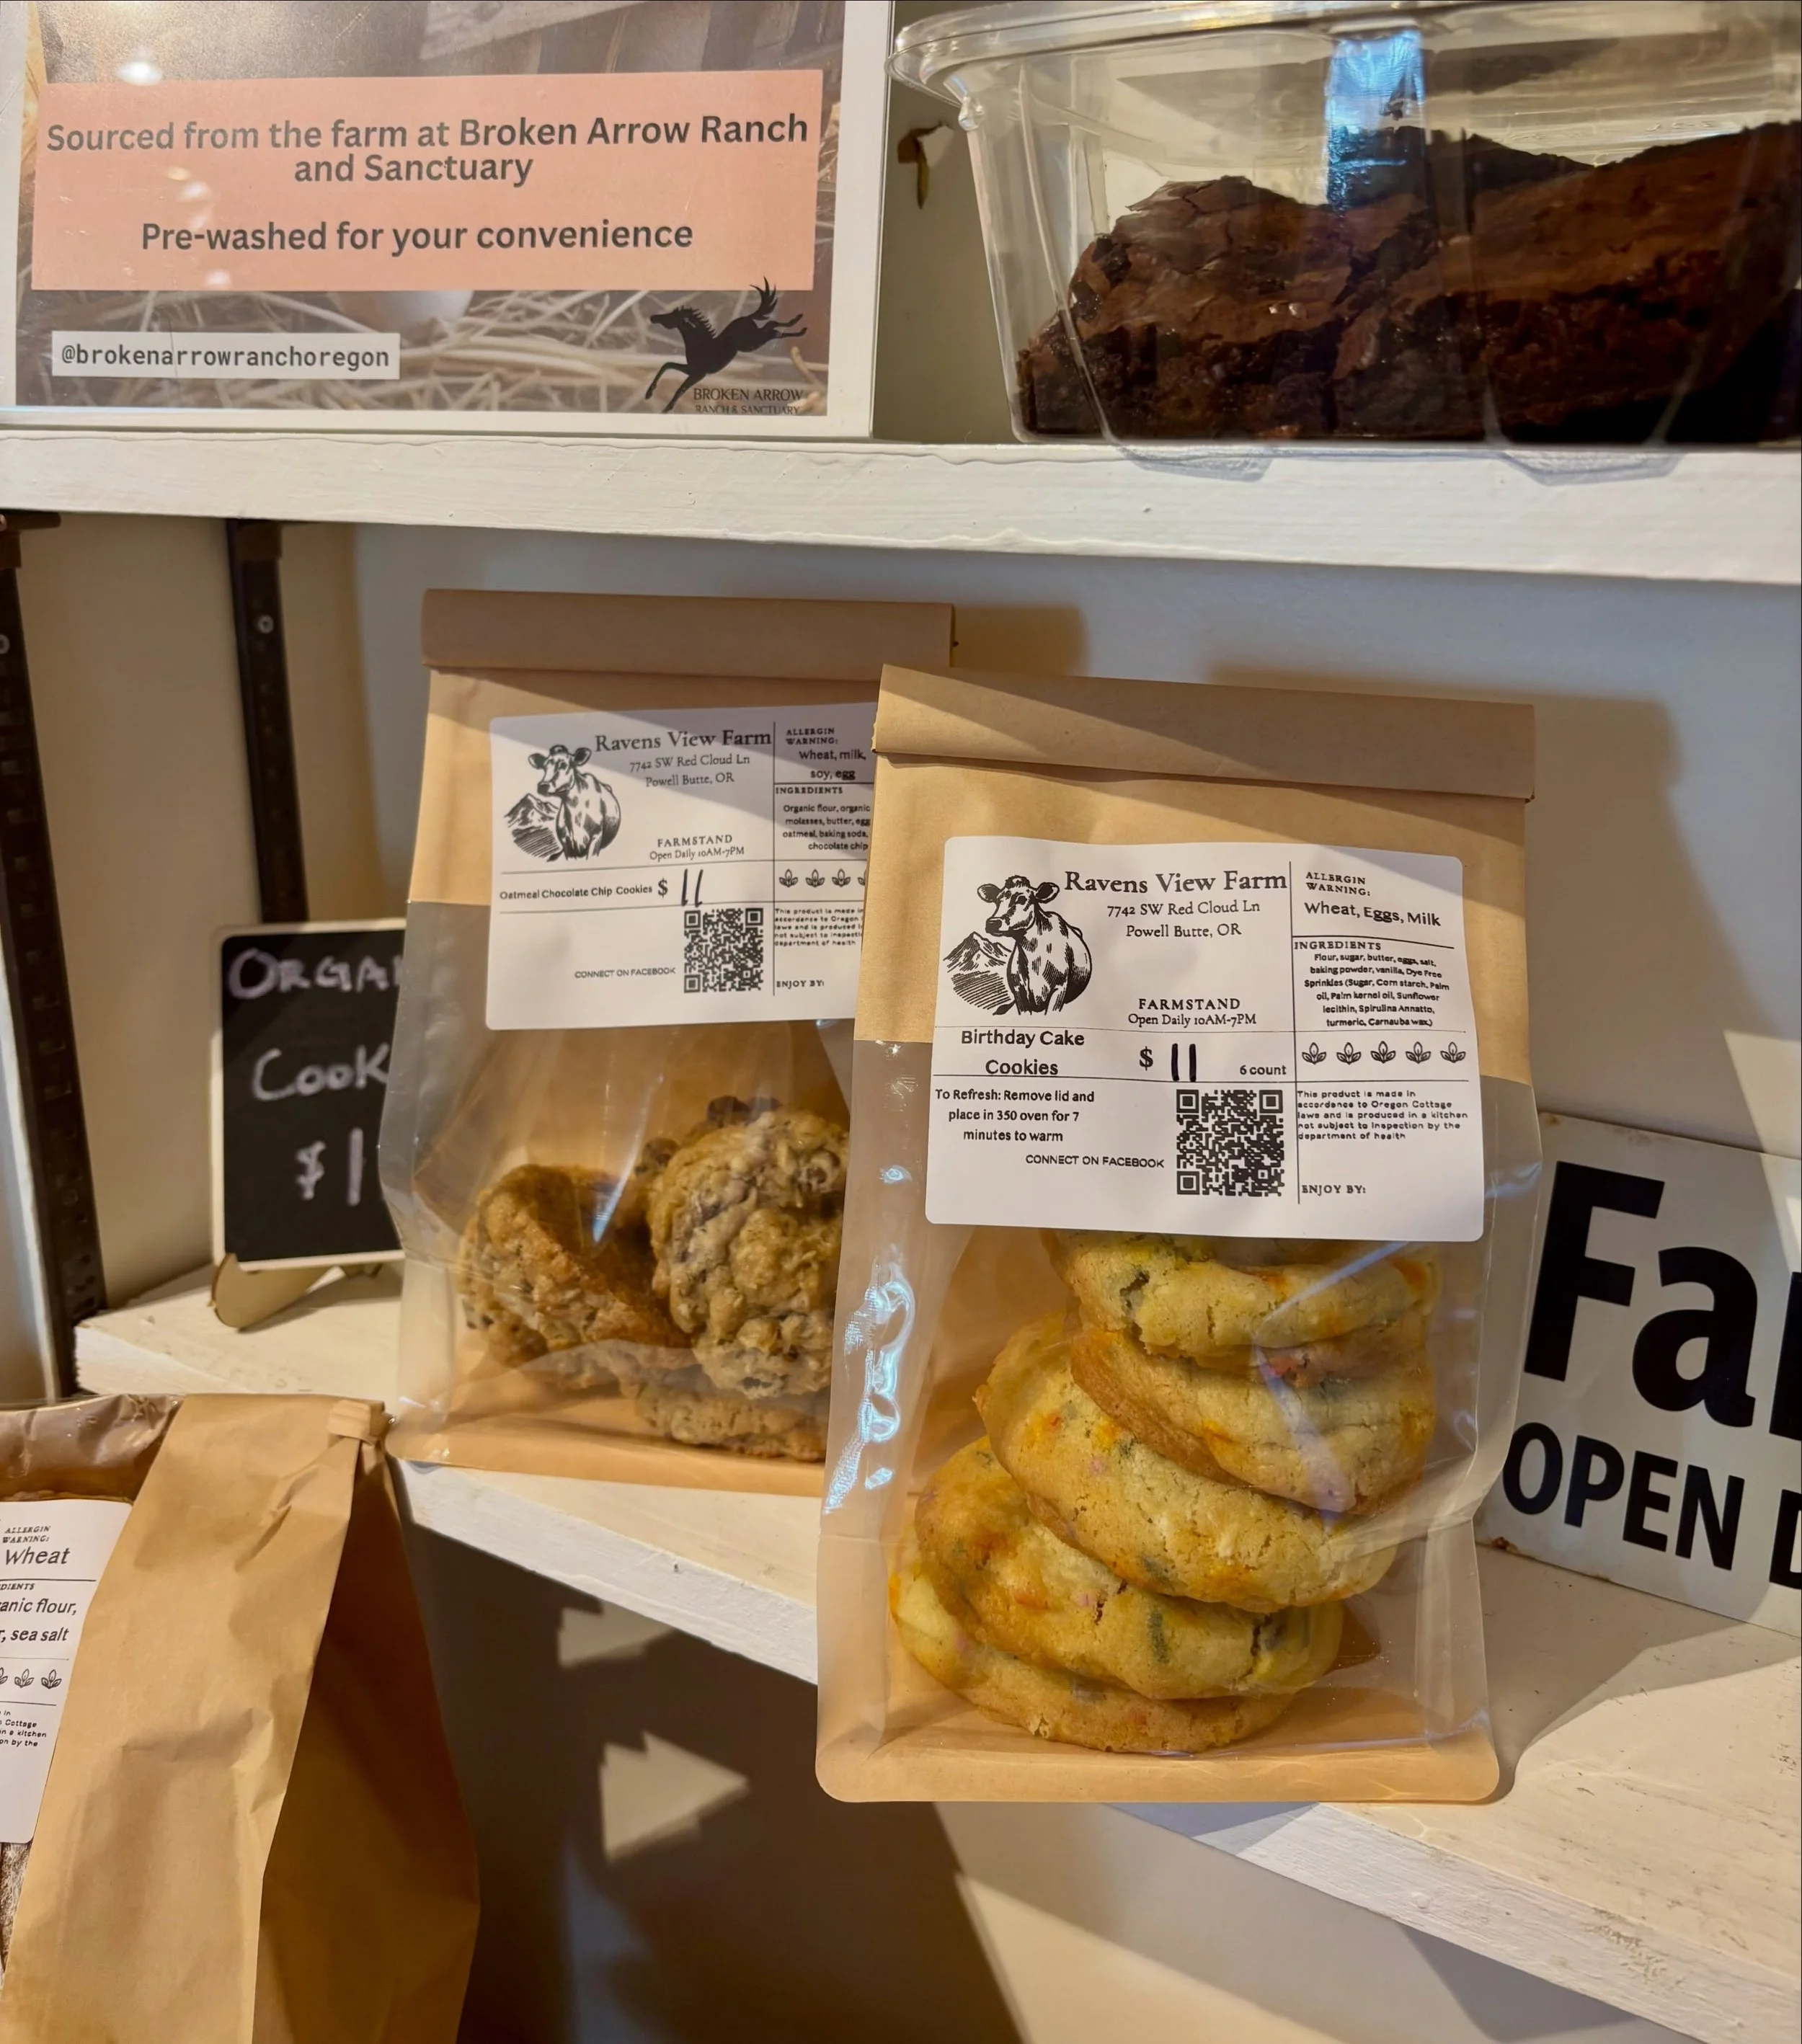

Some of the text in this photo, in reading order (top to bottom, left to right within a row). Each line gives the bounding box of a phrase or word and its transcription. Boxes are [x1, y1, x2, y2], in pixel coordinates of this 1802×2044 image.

[46, 113, 809, 151] Sourced from the farm at Broken Arrow Ranch
[294, 153, 534, 189] and Sanctuary
[142, 219, 694, 257] Pre-washed for your convenience
[61, 343, 391, 372] @brokenarrowranchoregon
[693, 388, 804, 401] BROKEN ARROW
[695, 404, 801, 415] RANCH & SANCTUARY
[786, 727, 835, 736] ALLERGIN
[595, 729, 772, 752] Ravens View Farm
[629, 753, 750, 773] 7742 SW Red Cloud Ln
[645, 772, 735, 787] Powell Butte, OR
[810, 770, 856, 781] soy, egg
[783, 804, 871, 814] Organic flour, organic
[657, 834, 734, 848] FARMSTAND
[649, 850, 673, 862] Open
[675, 848, 696, 861] Daily
[1064, 870, 1288, 894] Ravens View Farm
[1305, 871, 1366, 885] ALLERGIN
[500, 889, 540, 900] Oatmeal
[541, 887, 589, 899] Chocolate
[591, 887, 613, 897] Chip
[616, 884, 653, 896] Cookies
[1305, 882, 1371, 897] WARNING:
[1106, 899, 1261, 918] 7742 SW Red Cloud Ln
[1304, 901, 1442, 927] Wheat, Eggs, Milk
[1126, 923, 1242, 938] Powell Butte, OR
[1294, 941, 1382, 951] INGREDIENTS
[1314, 953, 1339, 962] Flour,
[1339, 954, 1366, 963] sugar,
[1367, 954, 1397, 964] butter,
[574, 967, 677, 979] CONNECT ON FACEBOOK
[1310, 966, 1442, 978] baking powder, vanilla, Dye Free
[776, 979, 807, 990] ENJOY
[1304, 978, 1344, 989] Sprinkles
[1344, 978, 1375, 989] (Sugar,
[1399, 979, 1429, 990] starch,
[1429, 981, 1450, 991] Palm
[1316, 992, 1330, 1001] oil,
[1353, 991, 1381, 1000] kernel
[1382, 991, 1395, 1000] oil,
[1396, 992, 1440, 1002] Sunflower
[1138, 998, 1240, 1010] FARMSTAND
[1323, 1005, 1436, 1015] lecithin, Spirulina Annatto,
[1128, 1013, 1159, 1028] Open
[1161, 1013, 1191, 1028] Daily
[961, 1028, 1085, 1049] Birthday Cake
[985, 1058, 1059, 1076] Cookies
[1240, 1065, 1287, 1075] 6 count
[935, 1088, 1095, 1103] To Refresh: Remove lid and
[949, 1108, 1080, 1122] place in 350 oven for 7
[963, 1129, 1064, 1142] minutes to warm
[1026, 1154, 1165, 1169] CONNECT ON FACEBOOK
[1301, 1184, 1367, 1196] ENJOY BY:
[1501, 1421, 1745, 1572] OPEN
[4, 1525, 51, 1534] ALLERGIN
[36, 1597, 77, 1616] flour,
[10, 1629, 38, 1642] sea
[40, 1627, 69, 1642] salt
